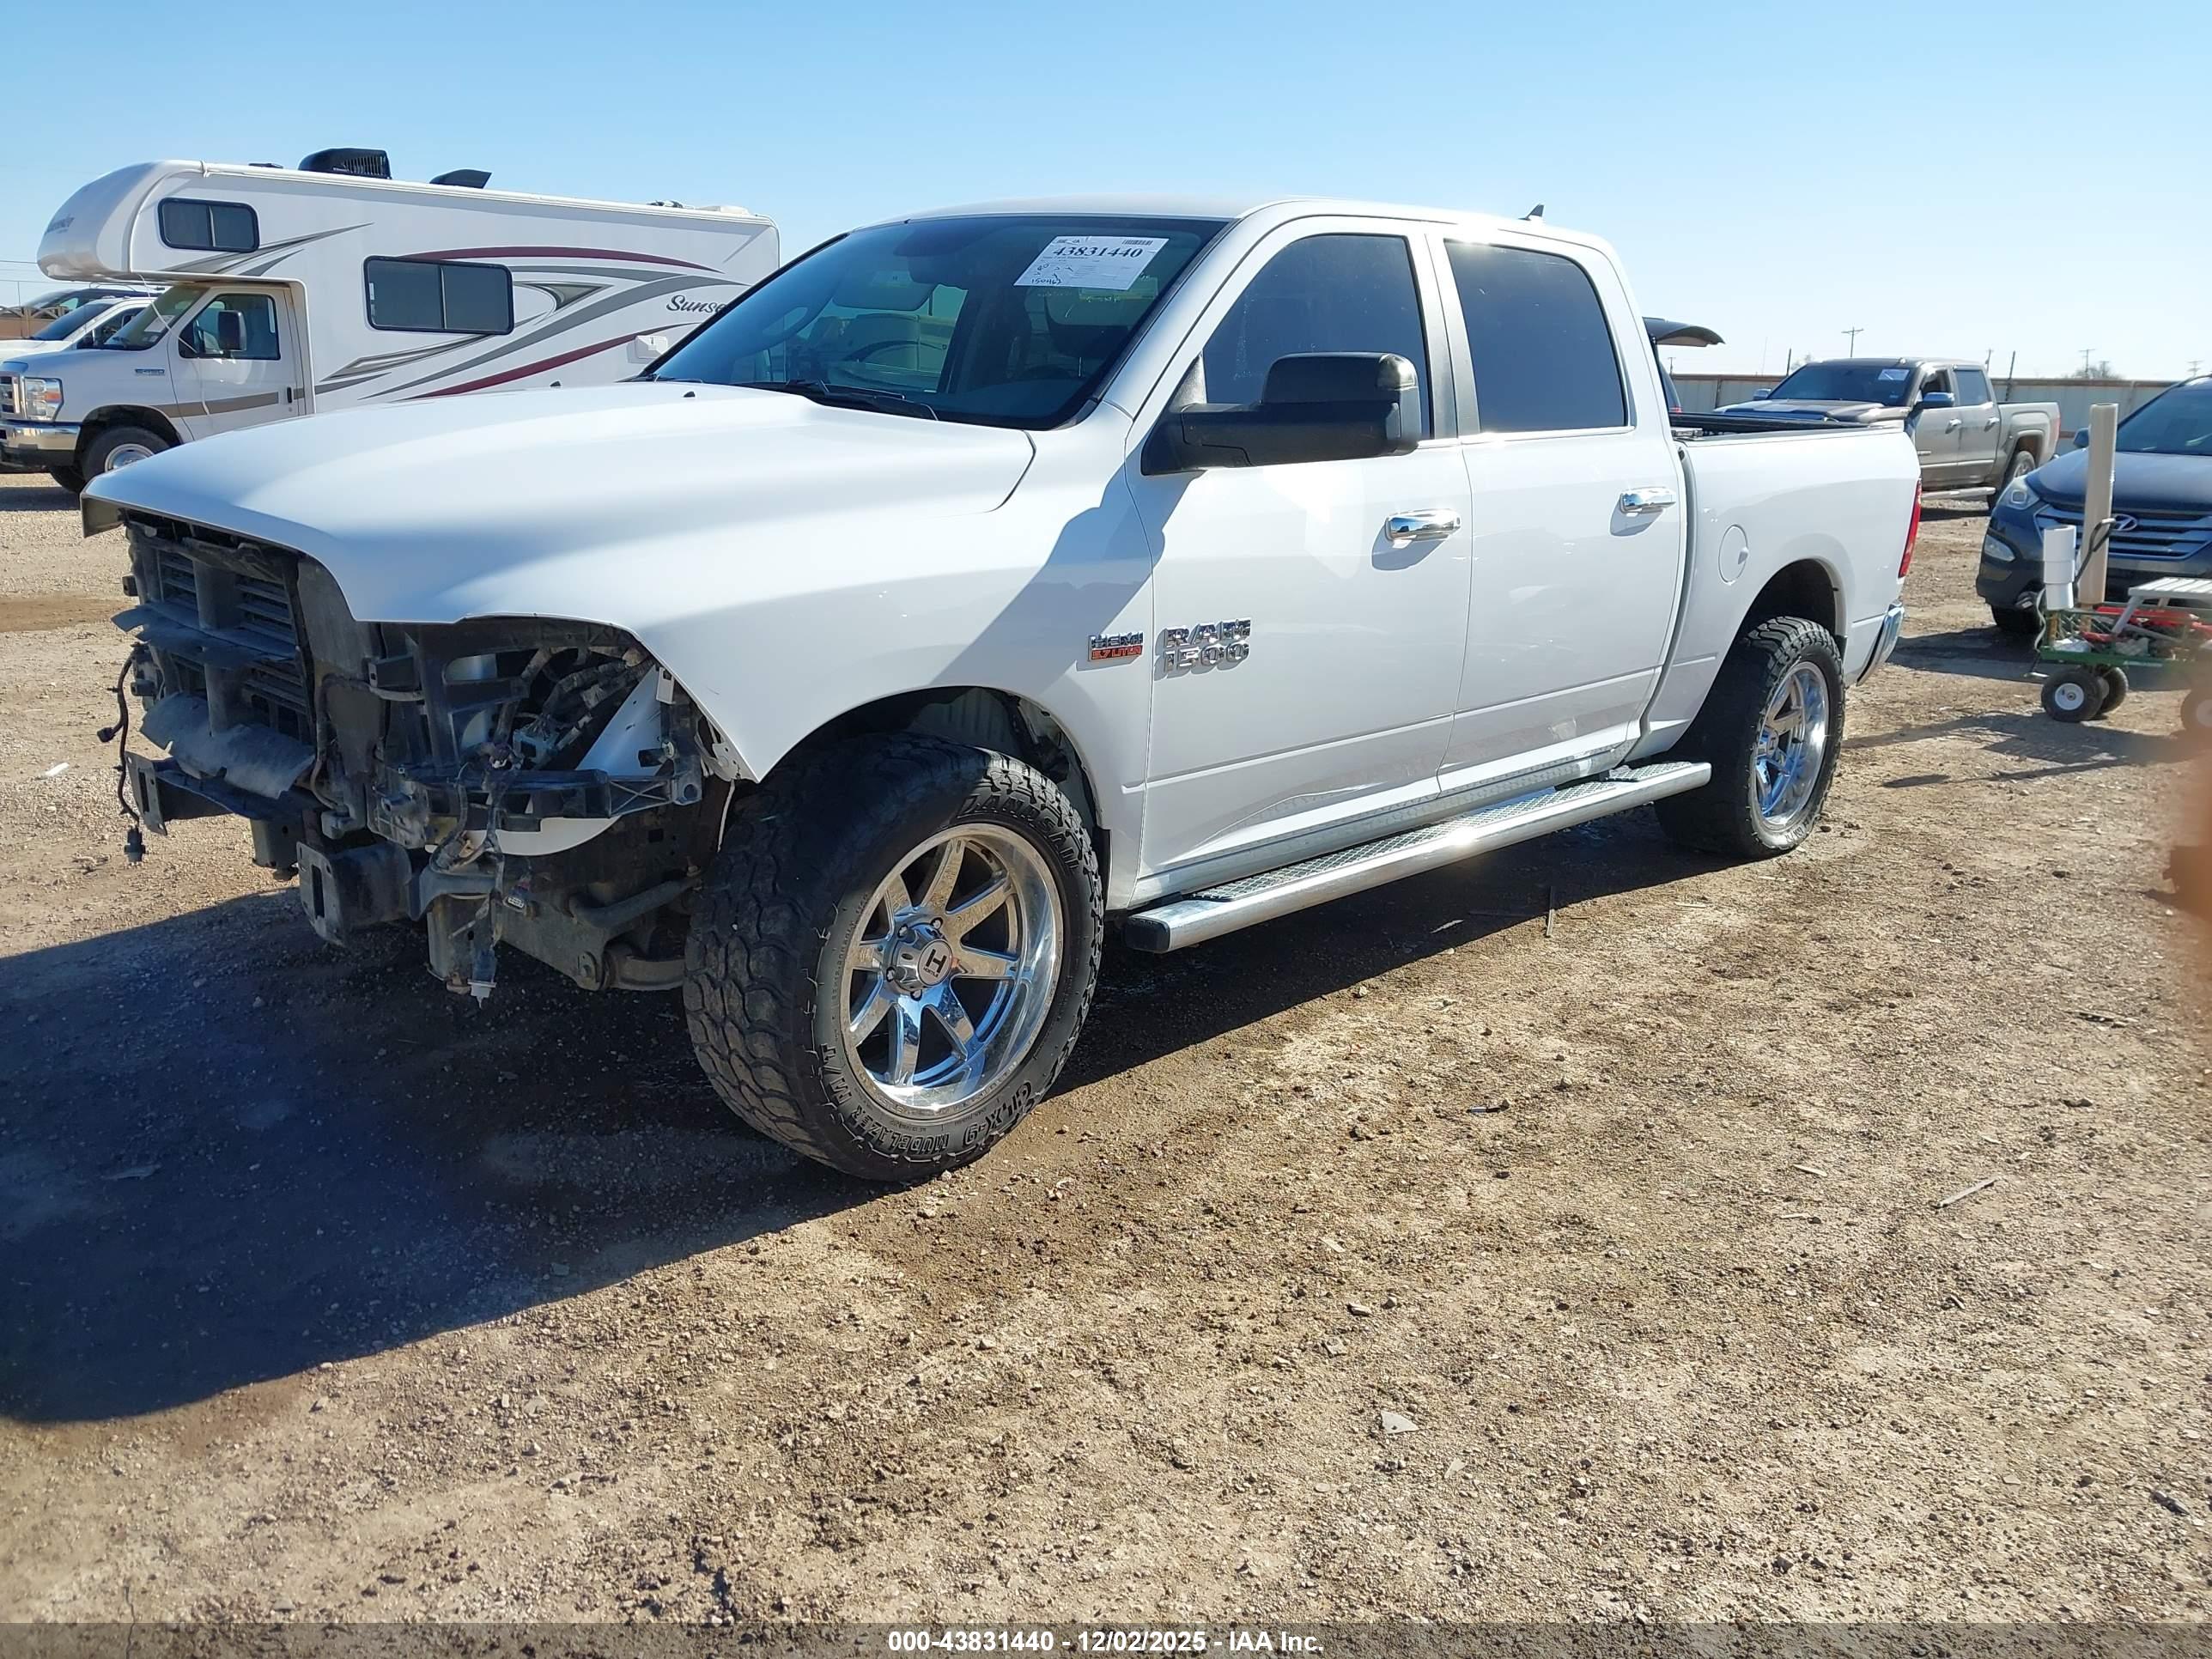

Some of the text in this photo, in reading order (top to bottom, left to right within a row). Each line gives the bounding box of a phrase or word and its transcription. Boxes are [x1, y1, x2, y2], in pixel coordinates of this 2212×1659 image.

[1053, 246, 1144, 258] 43831440
[1089, 632, 1143, 649] HEMI
[1162, 617, 1251, 648] RAM
[1091, 646, 1141, 660] 5.7 LITER
[1163, 642, 1250, 673] 1500
[820, 1043, 853, 1105] M/T
[851, 1105, 950, 1154] MUDBLAZER
